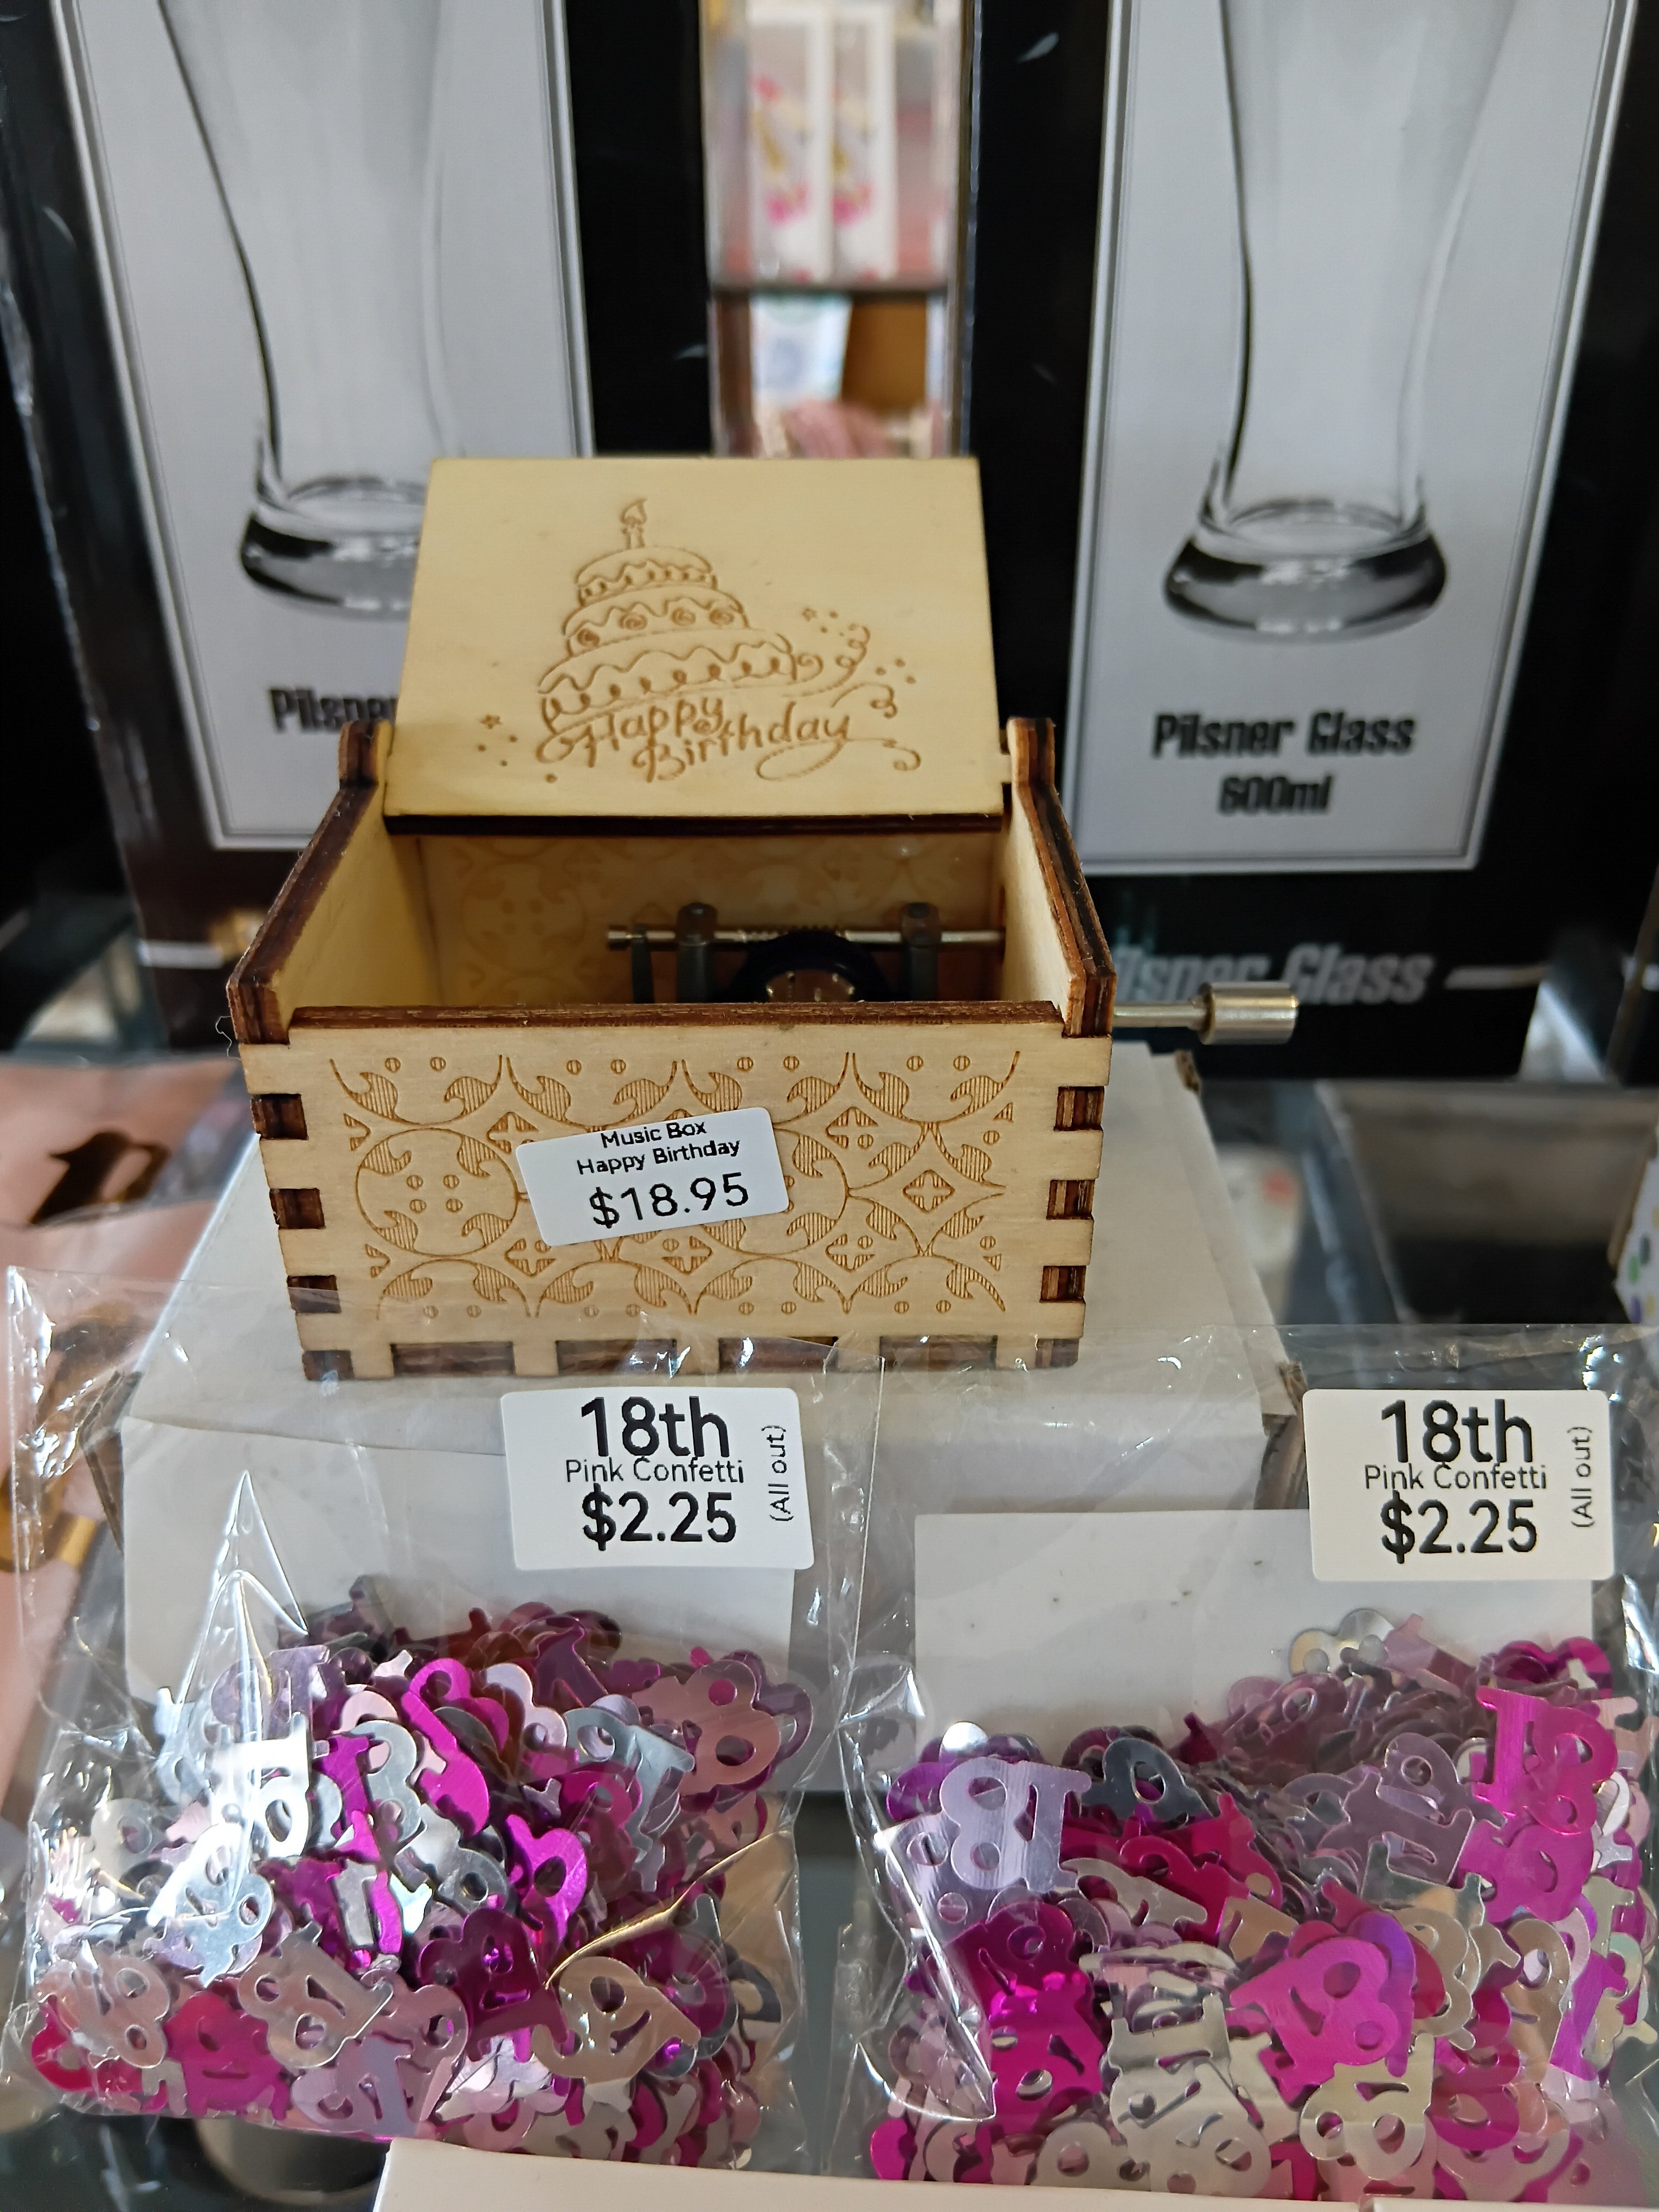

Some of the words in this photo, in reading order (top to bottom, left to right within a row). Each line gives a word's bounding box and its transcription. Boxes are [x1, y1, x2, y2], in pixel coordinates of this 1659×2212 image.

[537, 696, 724, 768] Happy
[633, 702, 850, 782] Birthday
[1151, 711, 1295, 759] Pilsner
[1306, 710, 1416, 758] Glass
[1218, 774, 1335, 815] 600ml
[577, 1153, 645, 1175] Happy
[653, 1140, 741, 1164] Birthday
[601, 1127, 663, 1148] Music
[666, 1121, 707, 1139] Box
[589, 1172, 749, 1229] $18.95
[581, 1396, 730, 1457] 18th
[761, 1424, 788, 1473] out)
[1381, 1399, 1534, 1463] 18th
[566, 1458, 623, 1483] Pink
[633, 1455, 744, 1483] Confetti
[1365, 1464, 1424, 1490] Pink
[1433, 1462, 1547, 1489] Confetti
[1567, 1426, 1593, 1477] out)
[582, 1483, 737, 1551] $2.25
[768, 1483, 794, 1522] (All
[1380, 1489, 1538, 1564] $2.25
[1571, 1487, 1595, 1528] (All
